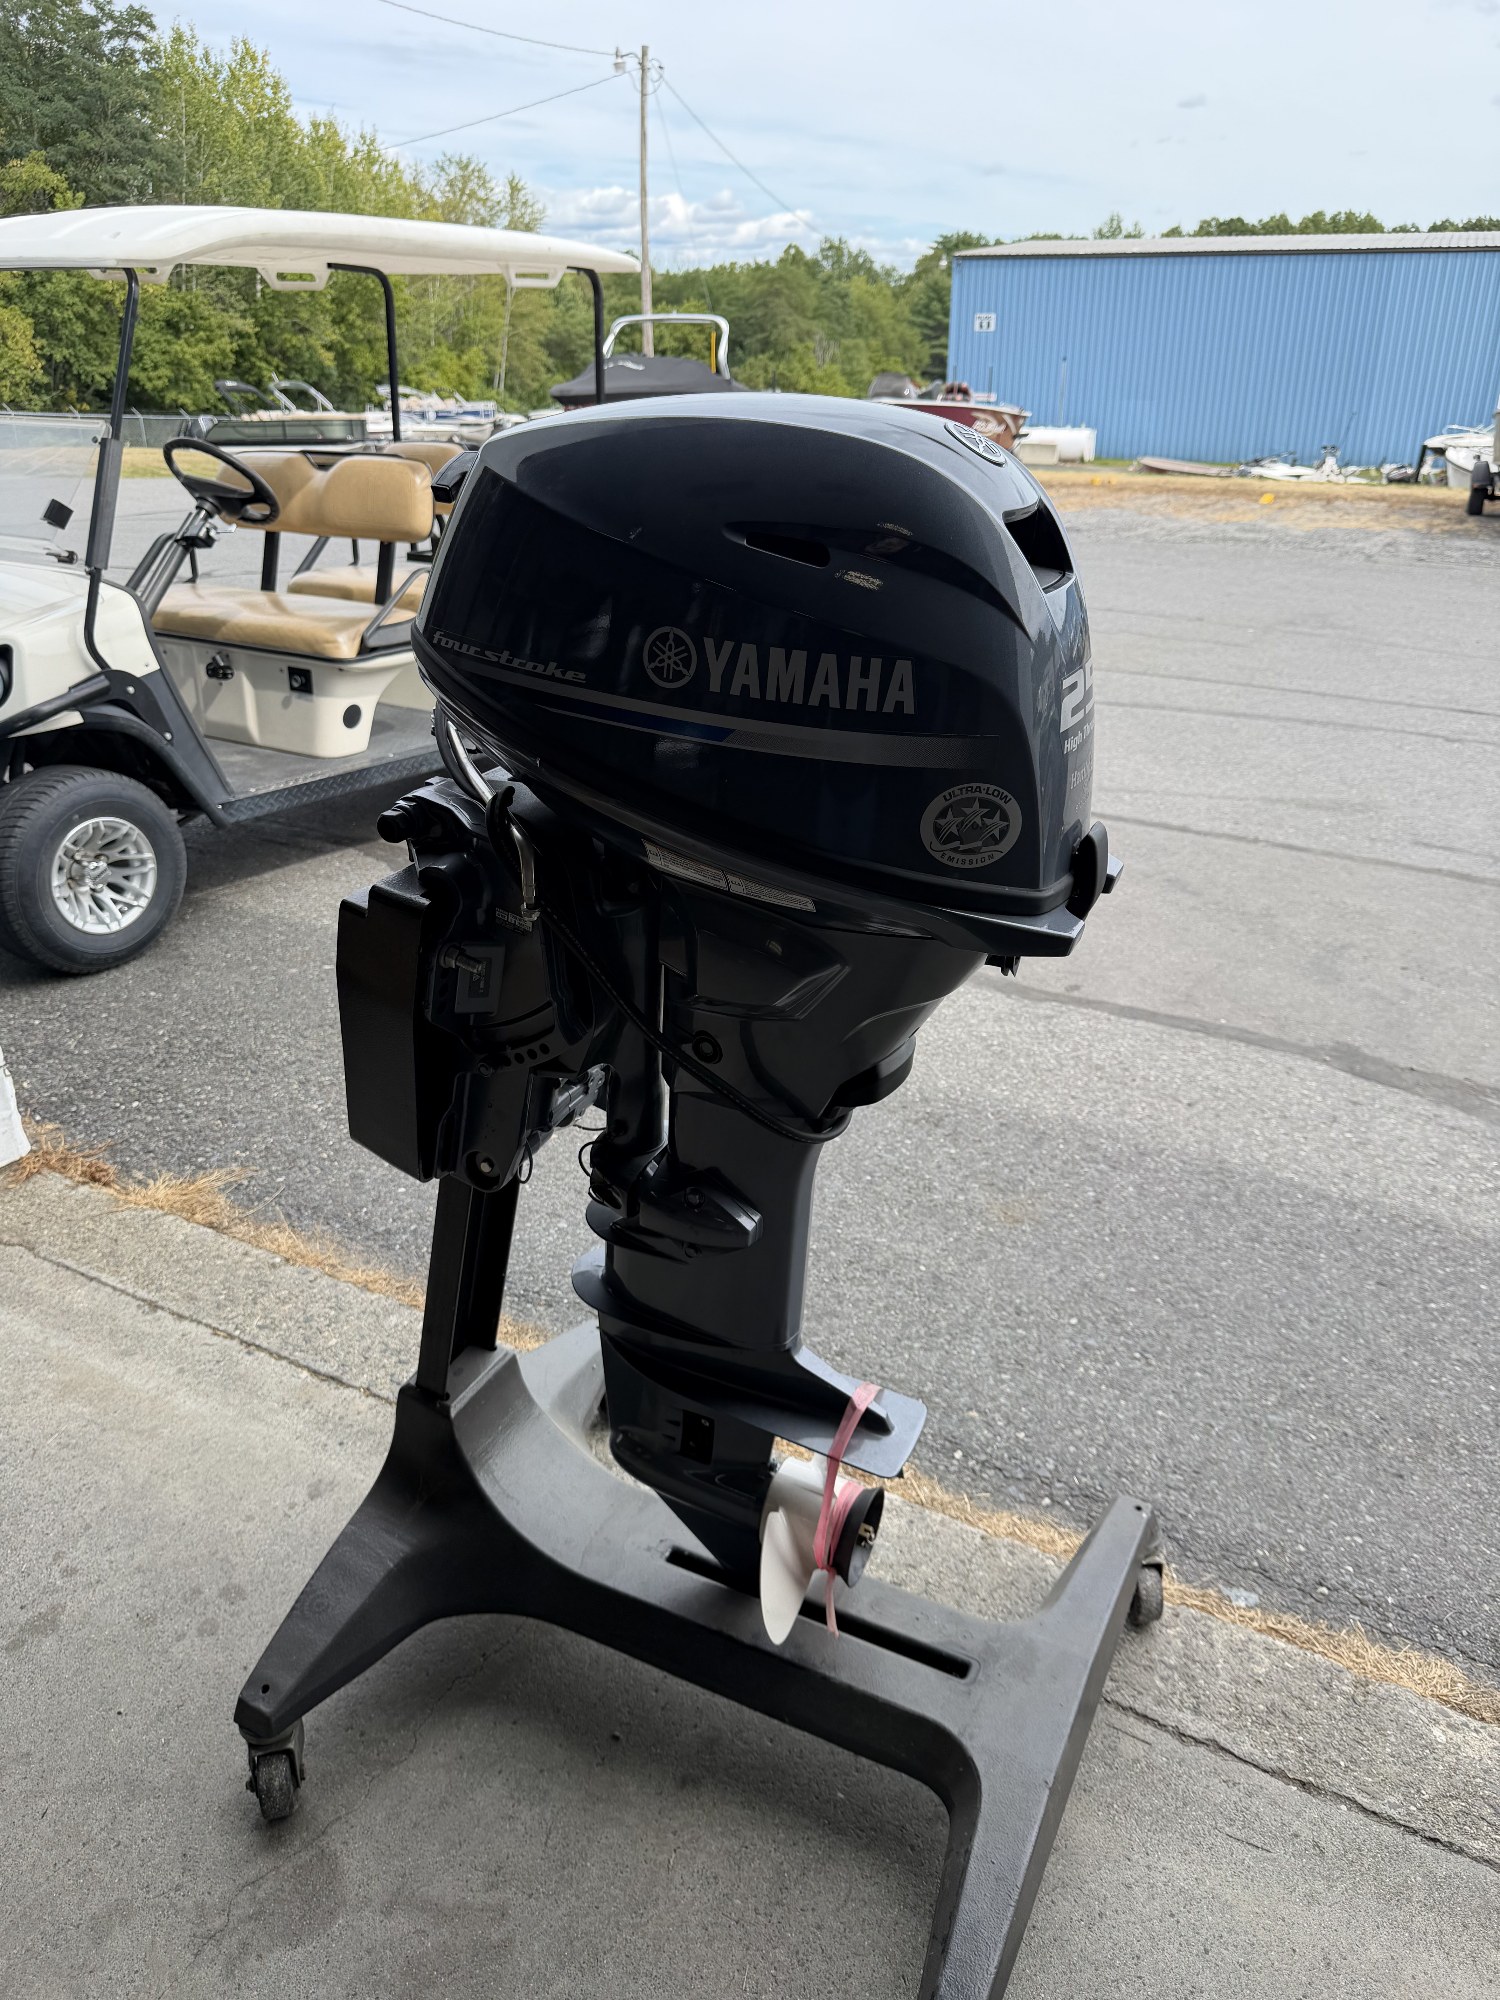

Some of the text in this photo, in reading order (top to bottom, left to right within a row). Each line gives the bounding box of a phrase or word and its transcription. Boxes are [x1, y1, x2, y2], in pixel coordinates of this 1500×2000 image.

[703, 636, 915, 715] YAMAHA
[1063, 731, 1083, 754] High
[940, 852, 994, 866] EMISSION
